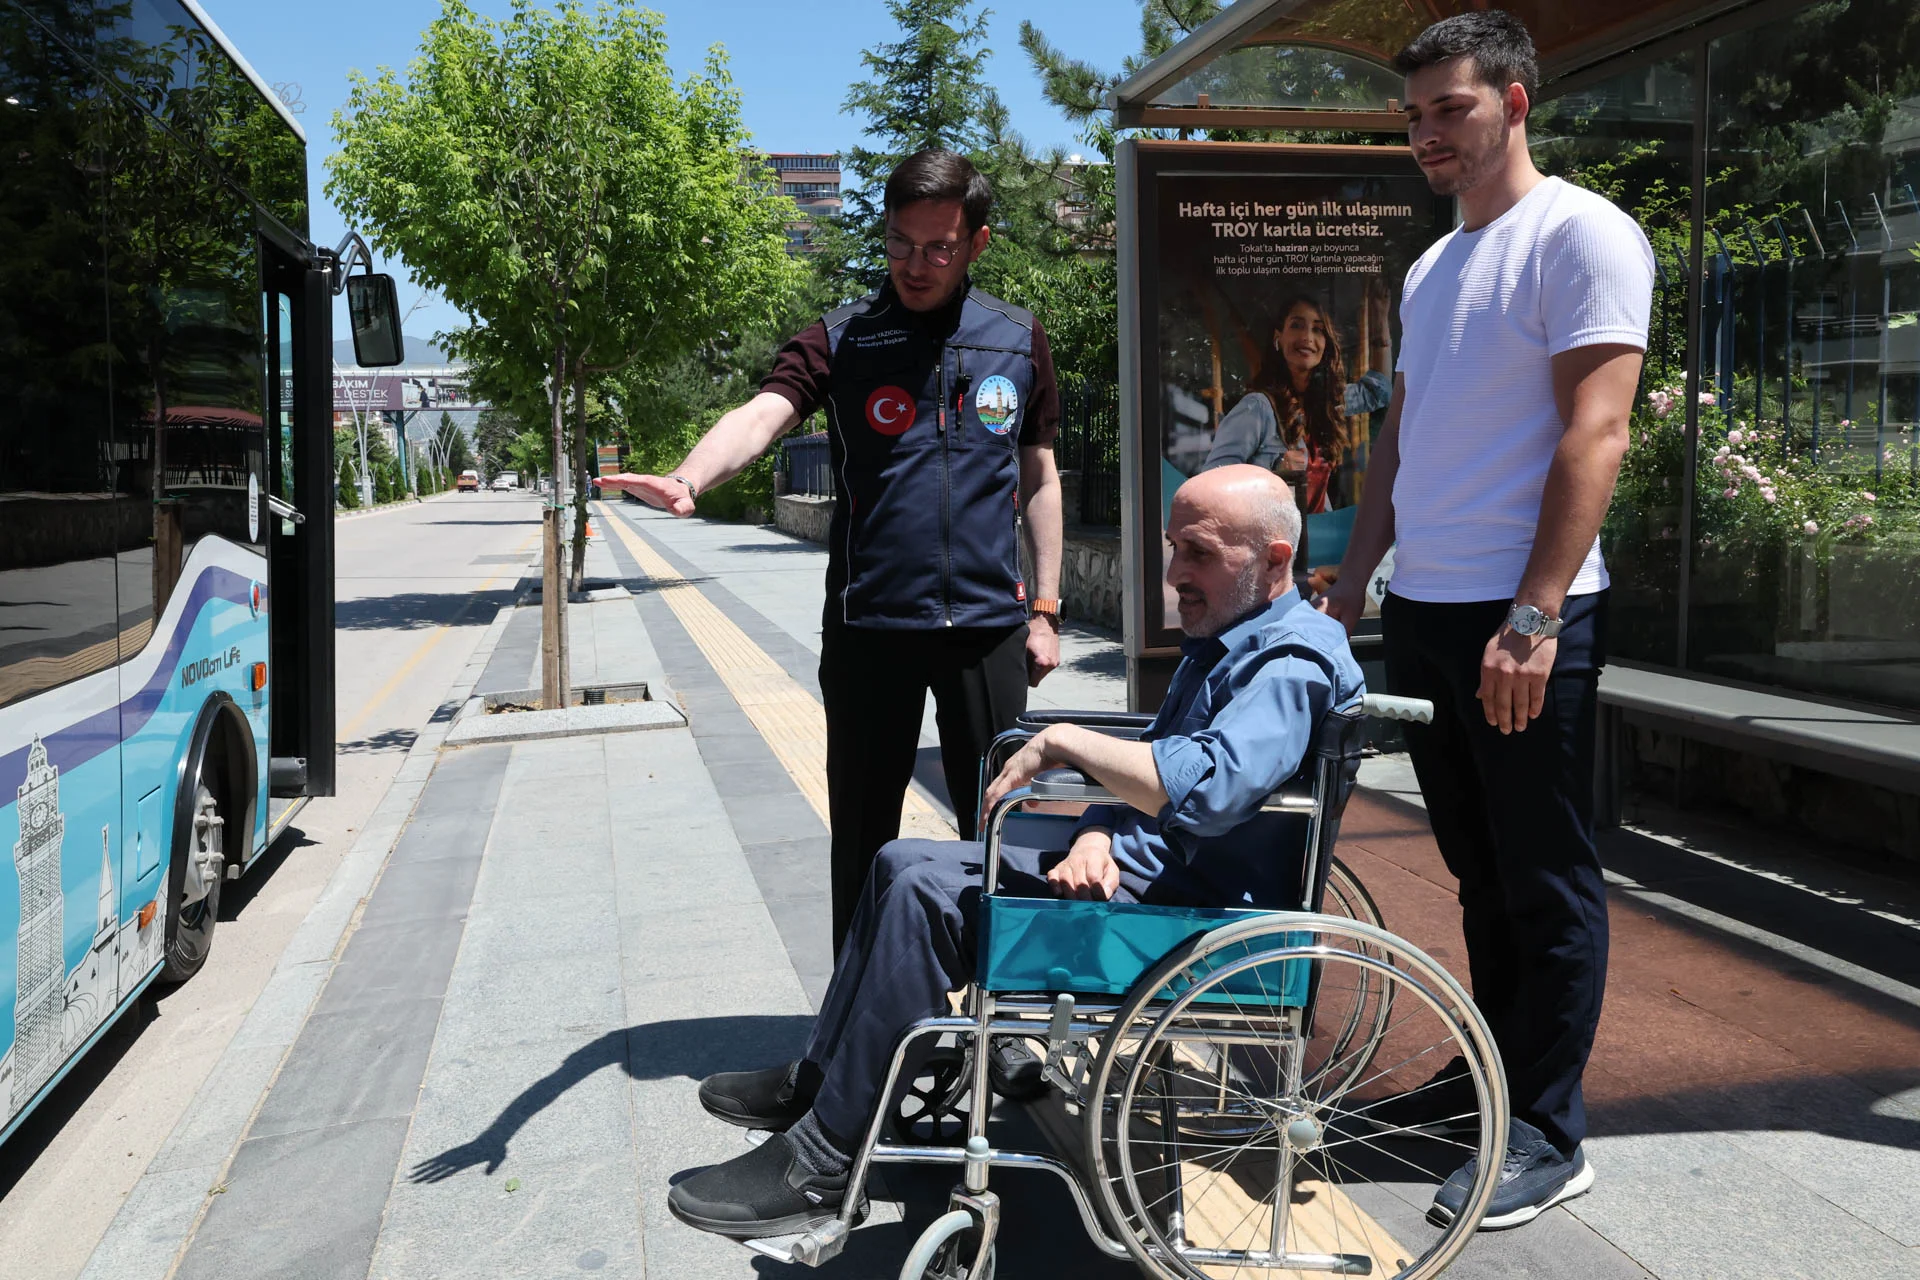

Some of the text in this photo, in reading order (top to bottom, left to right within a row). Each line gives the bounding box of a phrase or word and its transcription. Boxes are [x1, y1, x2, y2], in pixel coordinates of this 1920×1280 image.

[1179, 201, 1412, 221] Hafta içi her gün ilk ulaşımın
[1212, 221, 1384, 237] TROY kartla ücretsiz.
[1240, 243, 1360, 254] Tokat'ta haziran ayı boyunca
[1213, 254, 1384, 265] hafta içi her gün TROY kartınla yapacağın
[1216, 264, 1382, 276] ilk toplu ulaşım ödeme işlemin ücretsiz!
[333, 380, 368, 388] BAKIM
[344, 390, 388, 398] DESTEK
